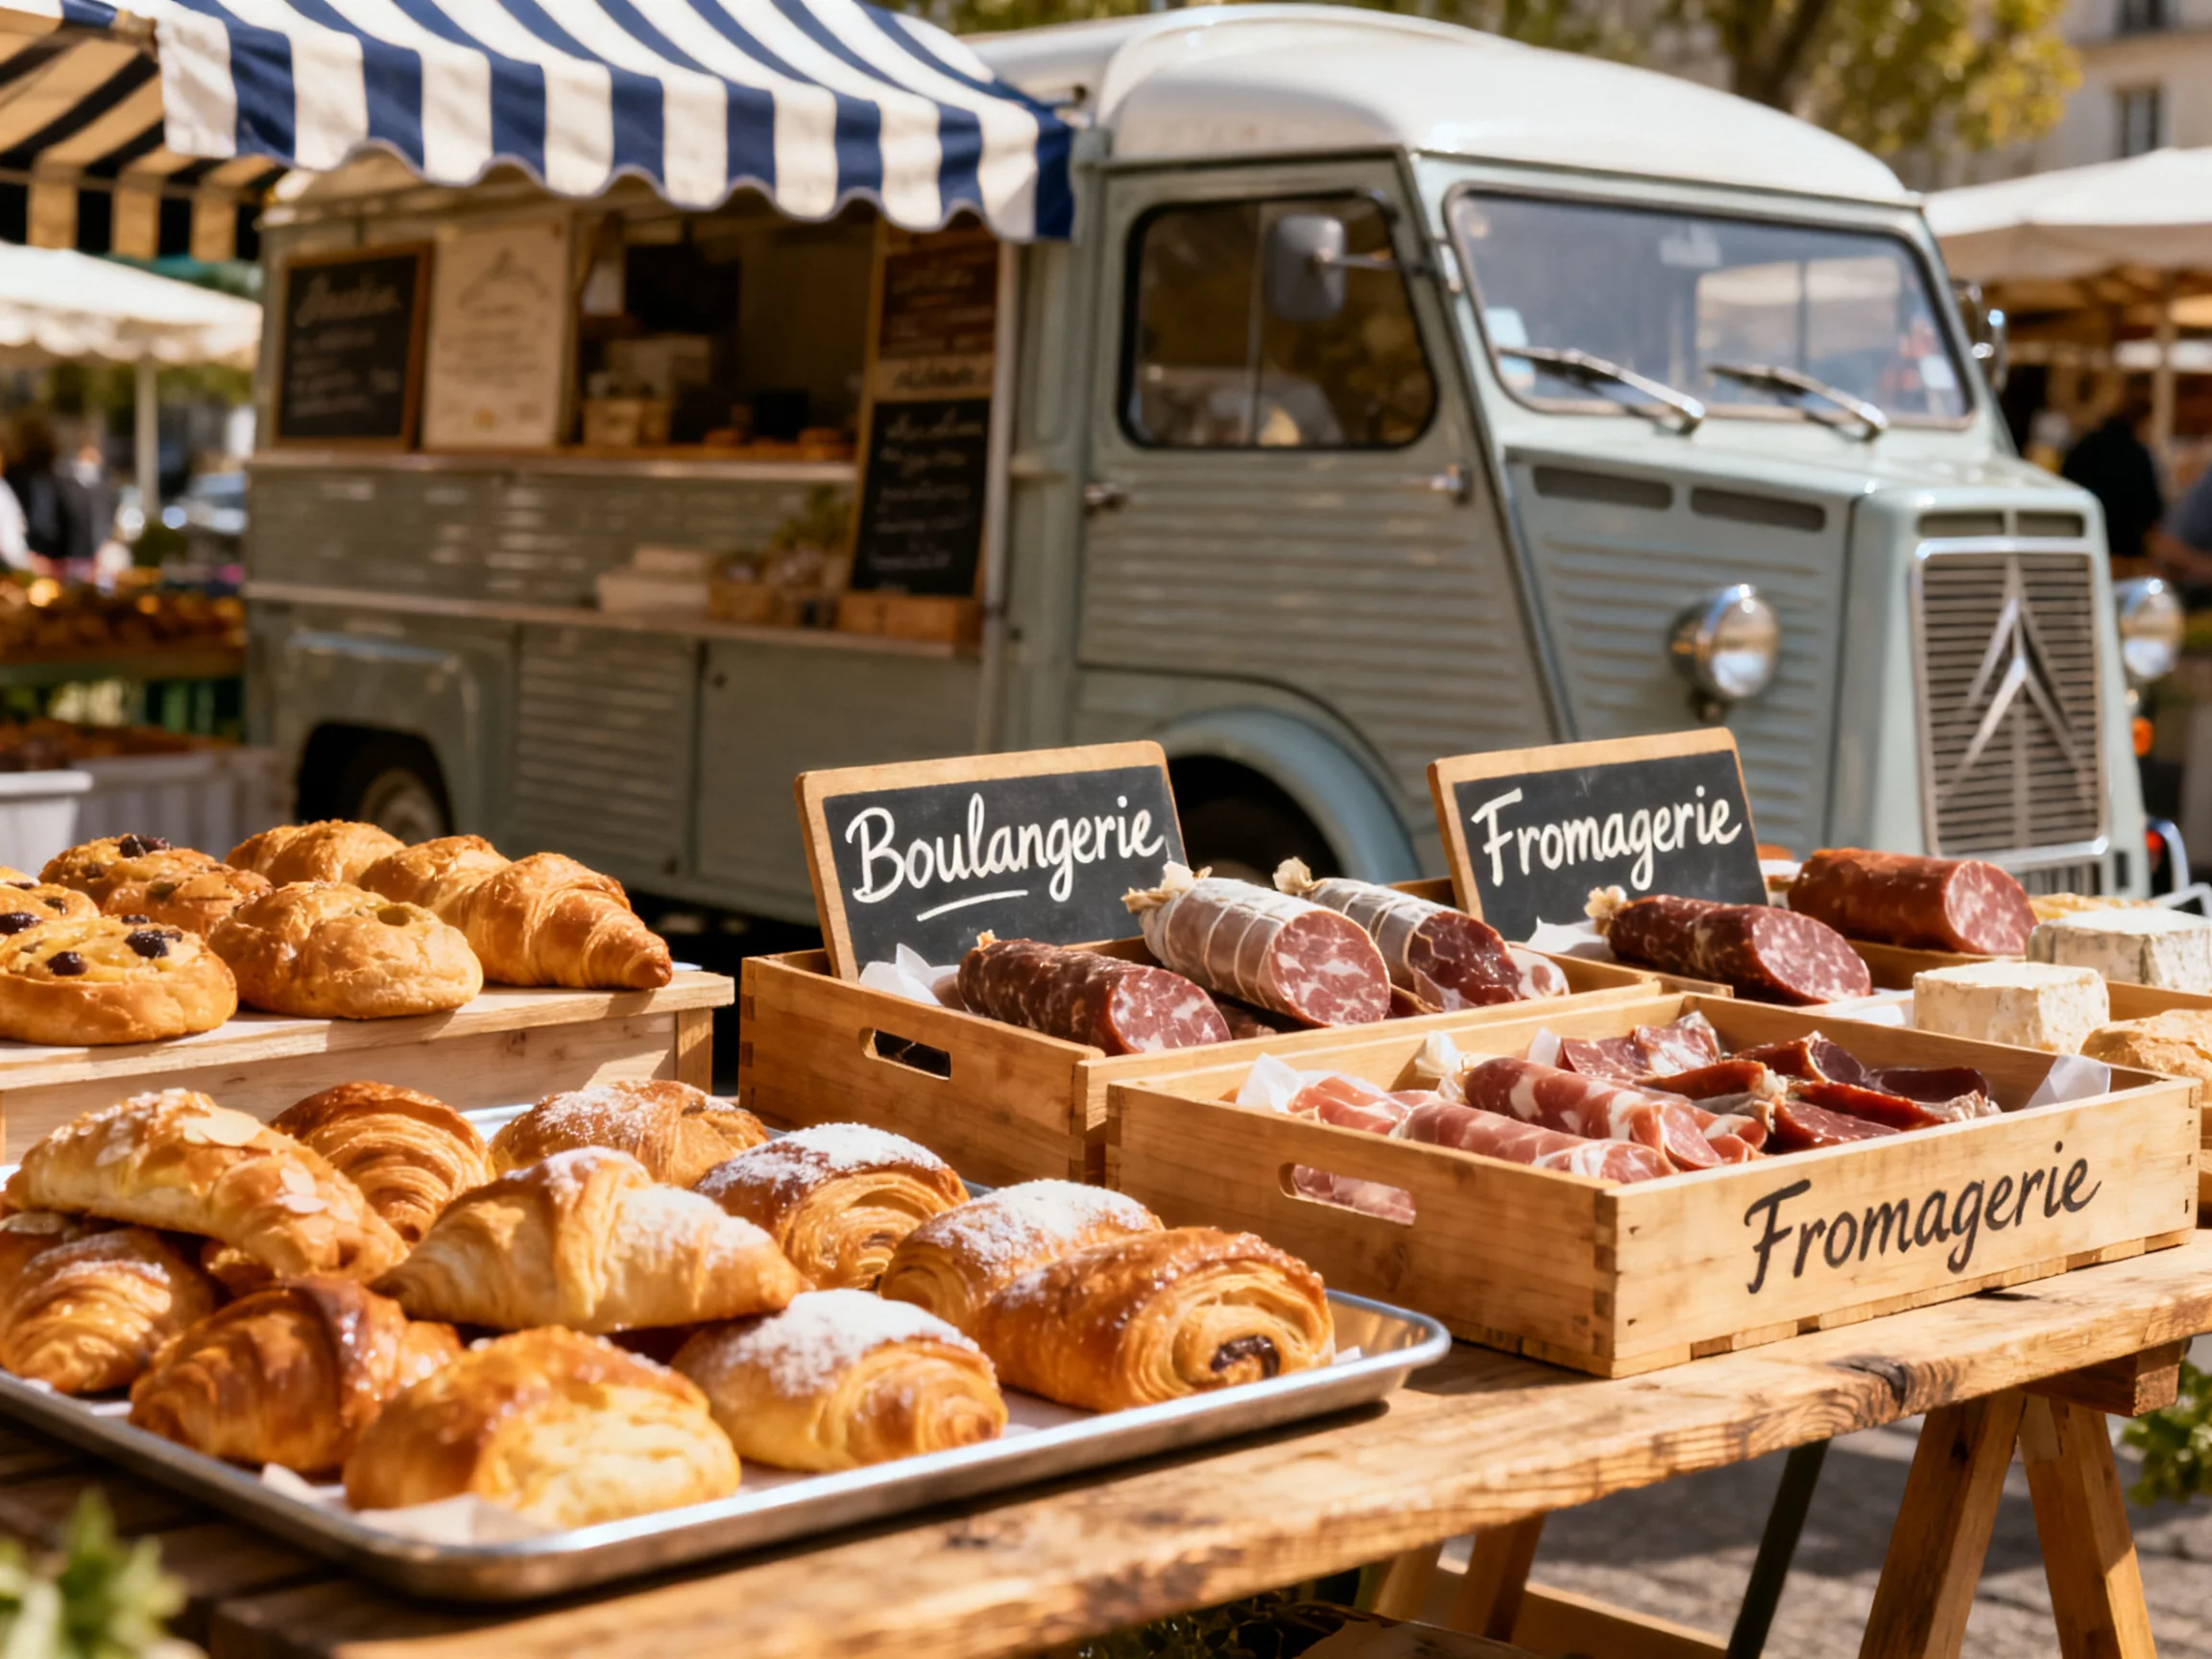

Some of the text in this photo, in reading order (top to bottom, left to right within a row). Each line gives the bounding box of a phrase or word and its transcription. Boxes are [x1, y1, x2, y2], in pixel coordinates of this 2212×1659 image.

[845, 792, 1165, 903] Boulangerie
[1470, 785, 1743, 891] Fromagerie
[1743, 1141, 2102, 1294] Fromagerie
